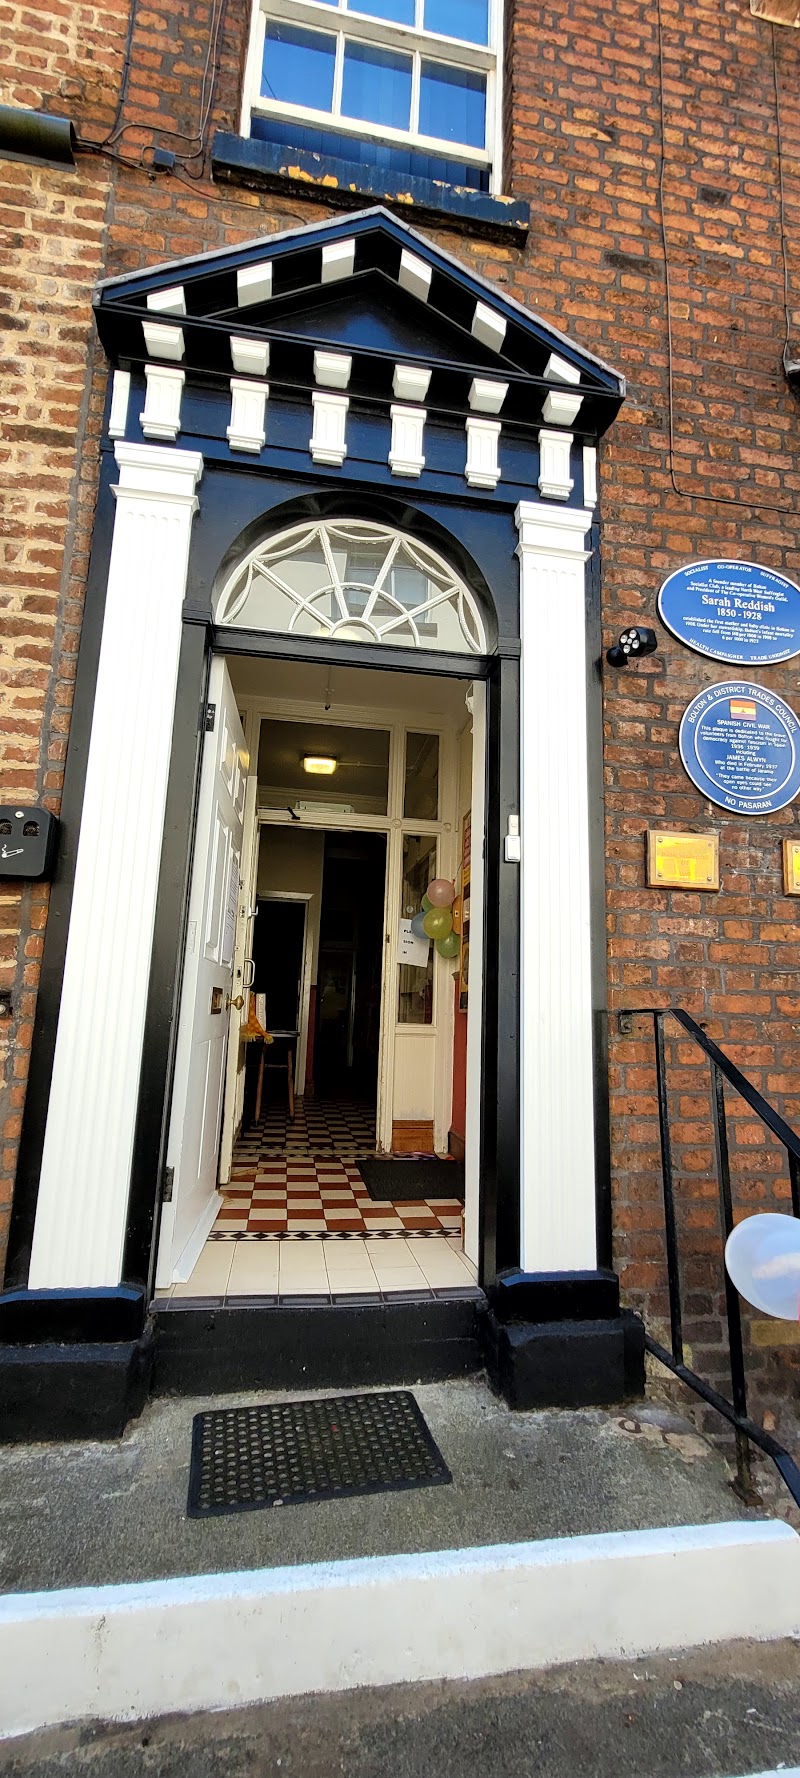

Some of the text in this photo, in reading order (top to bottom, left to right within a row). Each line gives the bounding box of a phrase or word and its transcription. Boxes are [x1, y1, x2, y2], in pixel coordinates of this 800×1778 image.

[684, 565, 709, 577] SOCIALIST
[716, 564, 752, 572] CO-OPERATOR
[702, 594, 775, 612] Sarah Reddish
[717, 608, 736, 618] 1850
[743, 610, 762, 620] 1928
[690, 638, 710, 651] HEALTH
[710, 648, 744, 659] CAMPAIGNER
[688, 698, 708, 724] BOLTON
[713, 686, 745, 697] DISTRICT
[748, 688, 774, 706] TRADES
[775, 704, 798, 734] COUNCIL
[725, 796, 772, 809] NO PASARAN
